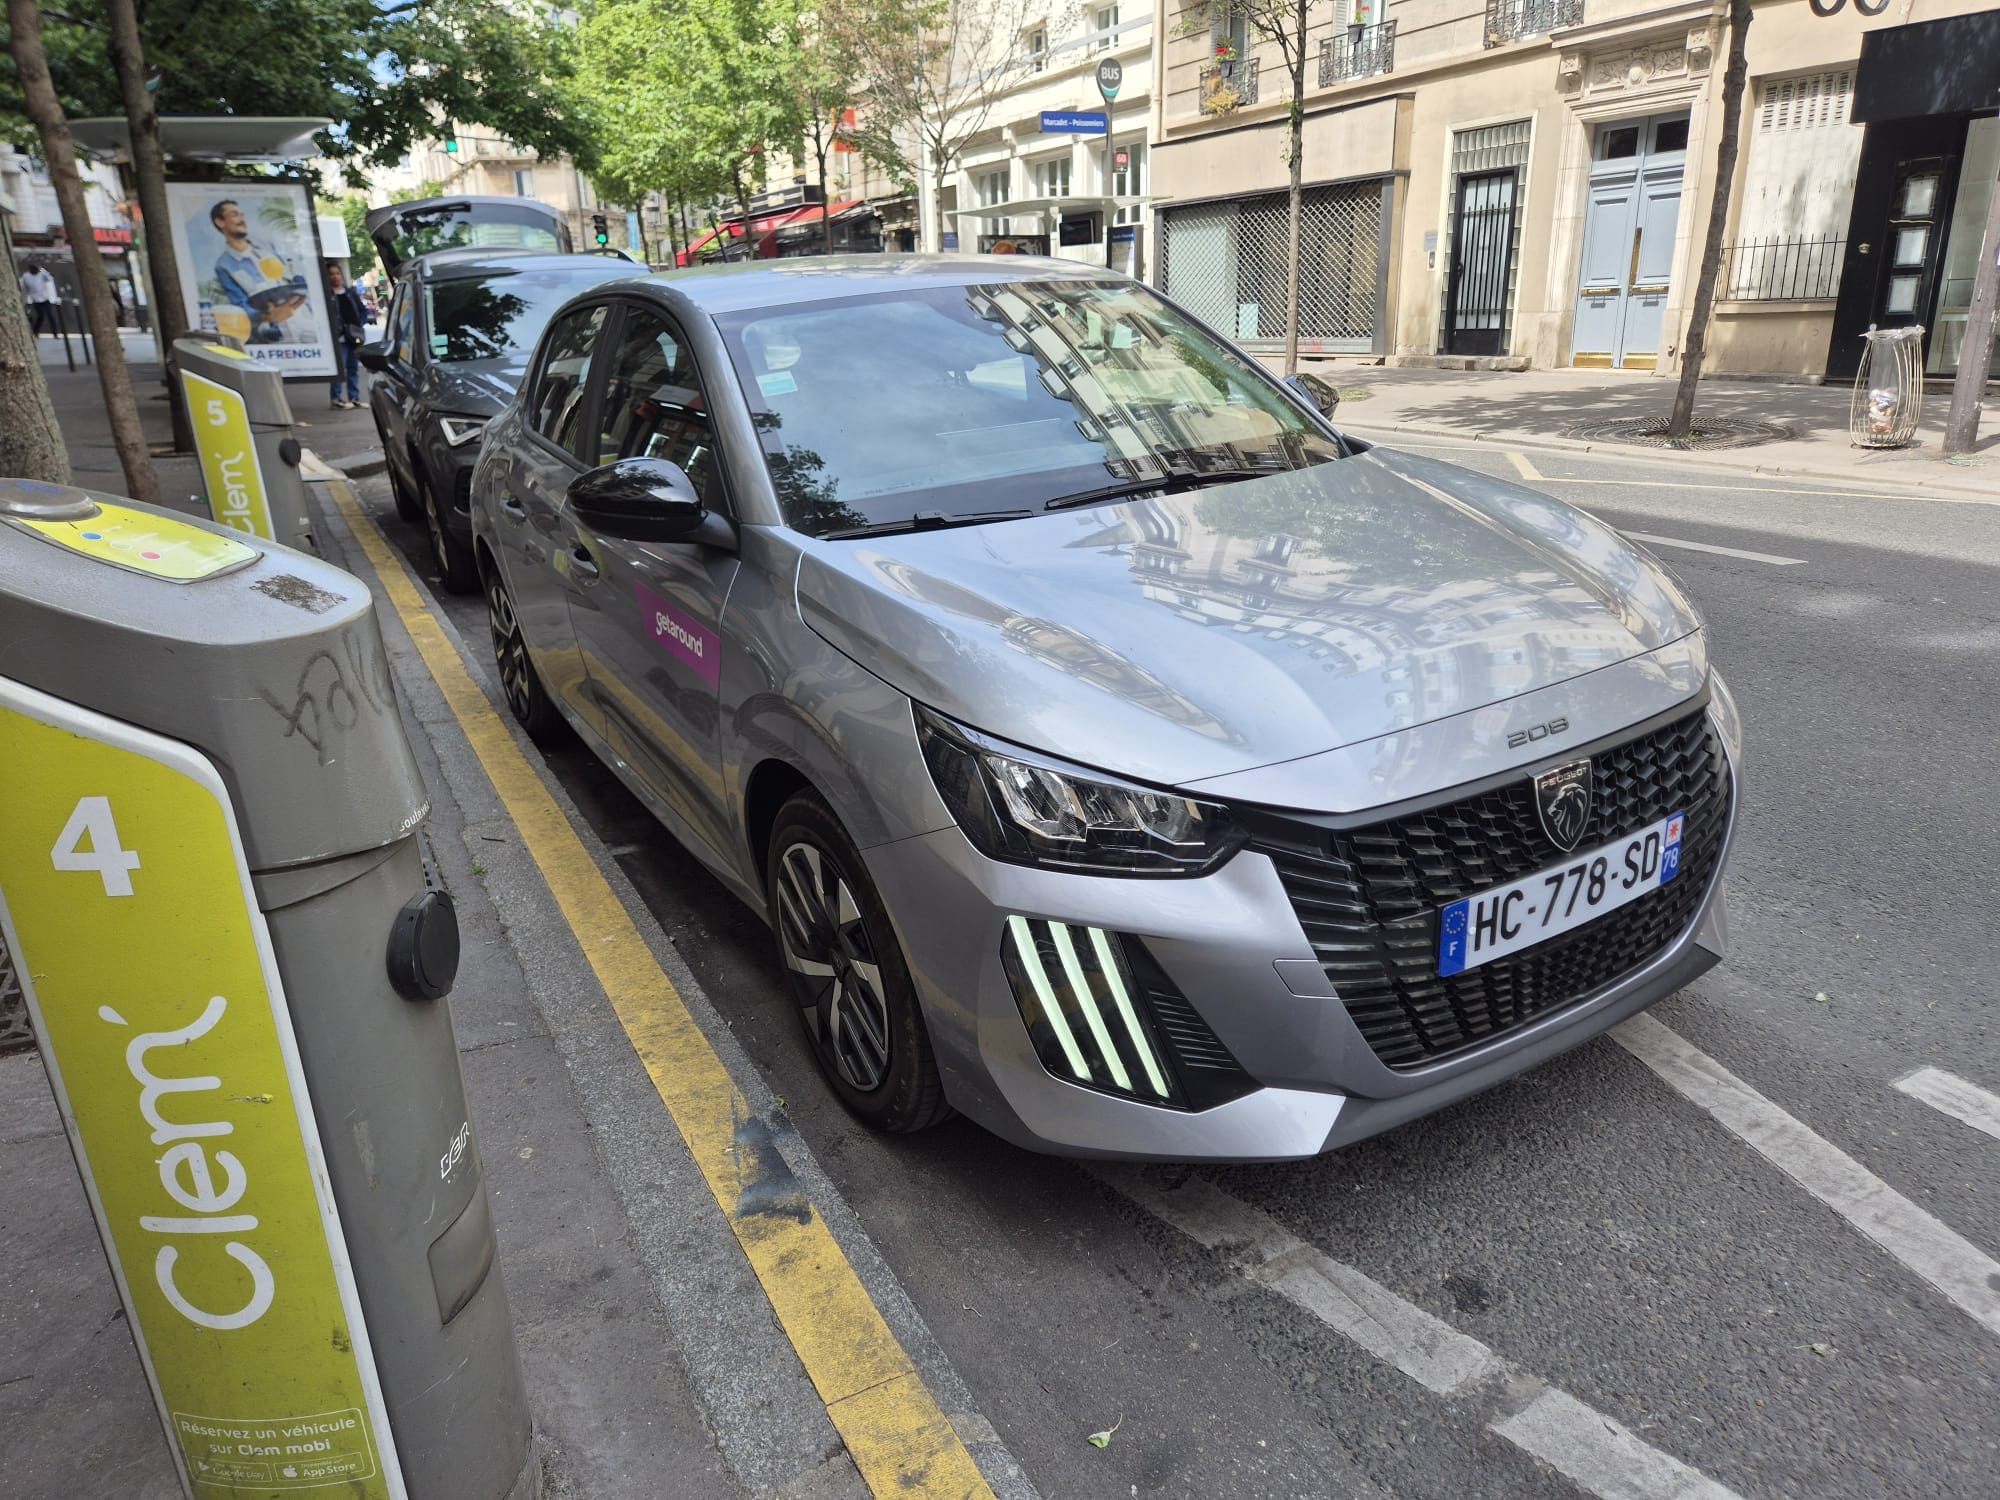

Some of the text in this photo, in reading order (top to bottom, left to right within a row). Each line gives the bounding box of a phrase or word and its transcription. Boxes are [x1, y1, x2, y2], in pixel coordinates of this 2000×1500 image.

[1101, 66, 1120, 80] BUS
[1043, 118, 1068, 126] Marcadet
[1116, 153, 1127, 163] 60
[268, 349, 321, 360] FRENCH
[207, 400, 227, 426] 5
[656, 611, 703, 658] getaround
[1507, 718, 1569, 749] 208
[1541, 767, 1587, 789] PEUGEOT
[50, 796, 141, 896] 4
[1662, 847, 1679, 873] 78
[1474, 831, 1661, 952] HC-778-SD
[1449, 941, 1458, 956] F
[181, 1418, 355, 1438] Réservez un véhicule
[209, 1439, 331, 1456] sur Clem mobi
[304, 1463, 356, 1477] App Store
